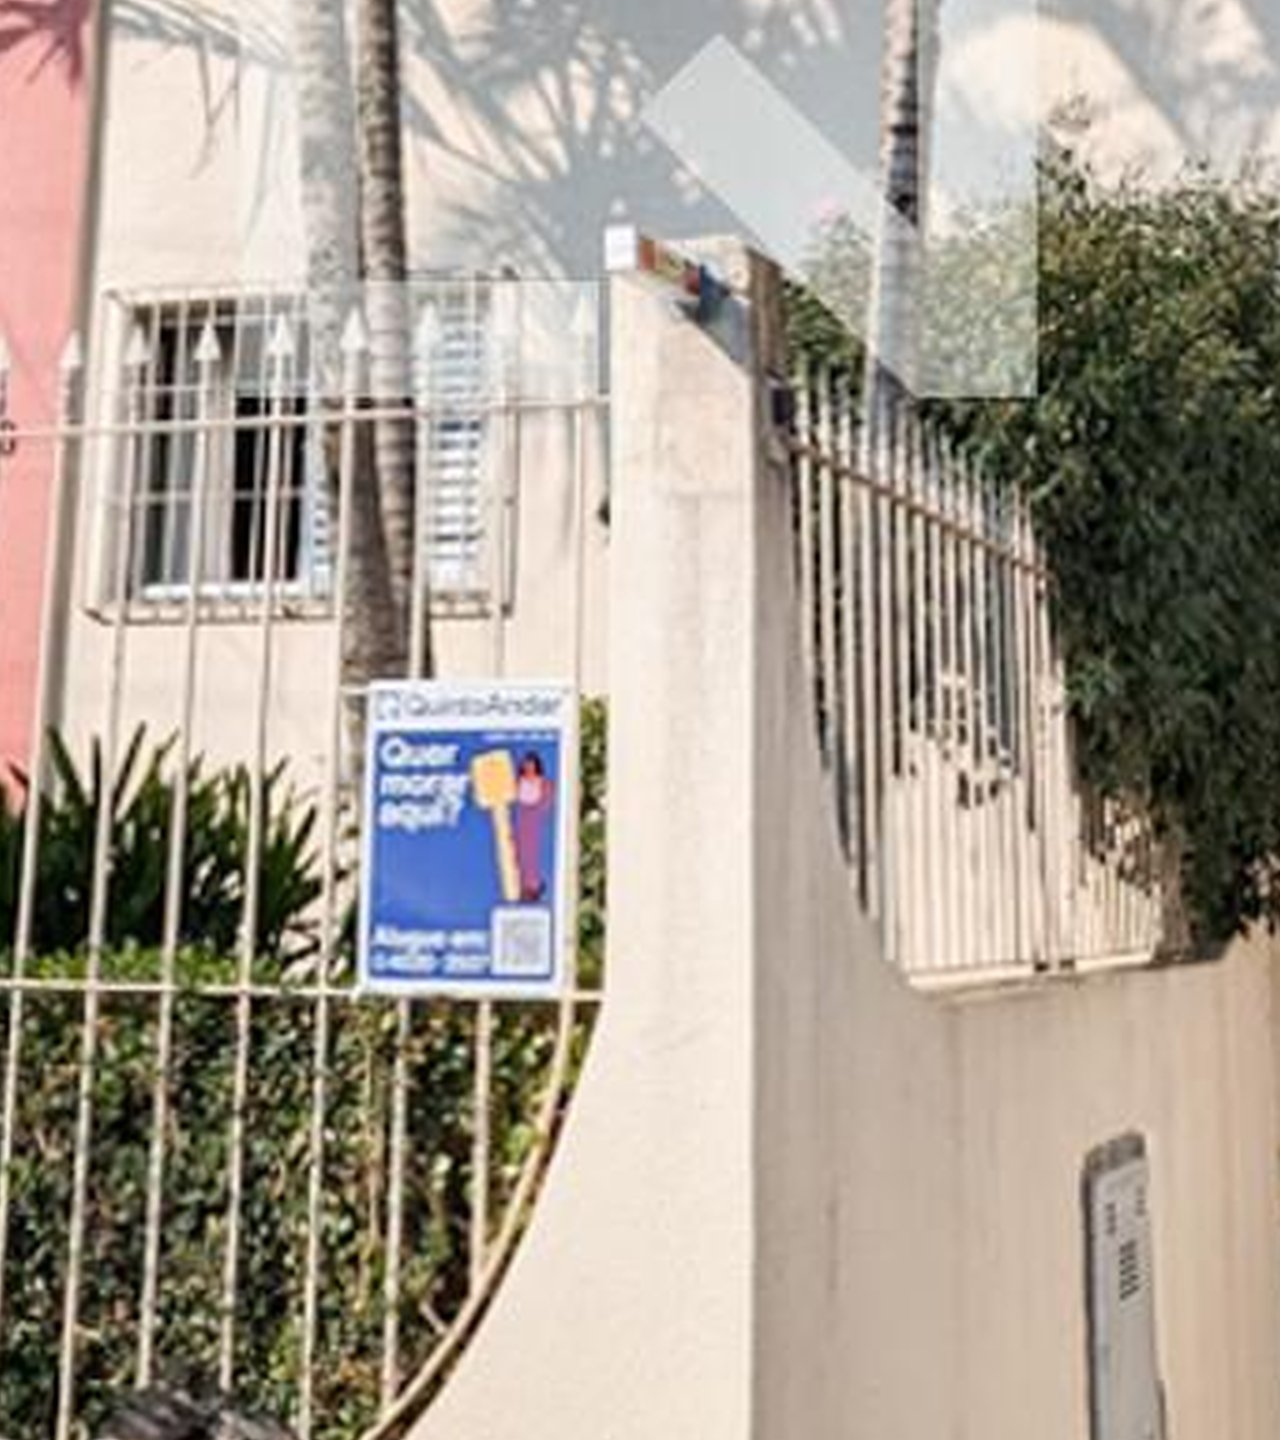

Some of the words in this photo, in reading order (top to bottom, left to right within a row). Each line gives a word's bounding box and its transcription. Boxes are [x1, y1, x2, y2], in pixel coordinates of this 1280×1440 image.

[380, 736, 459, 767] Quer
[380, 774, 469, 797] morar
[378, 796, 464, 832] aqui?
